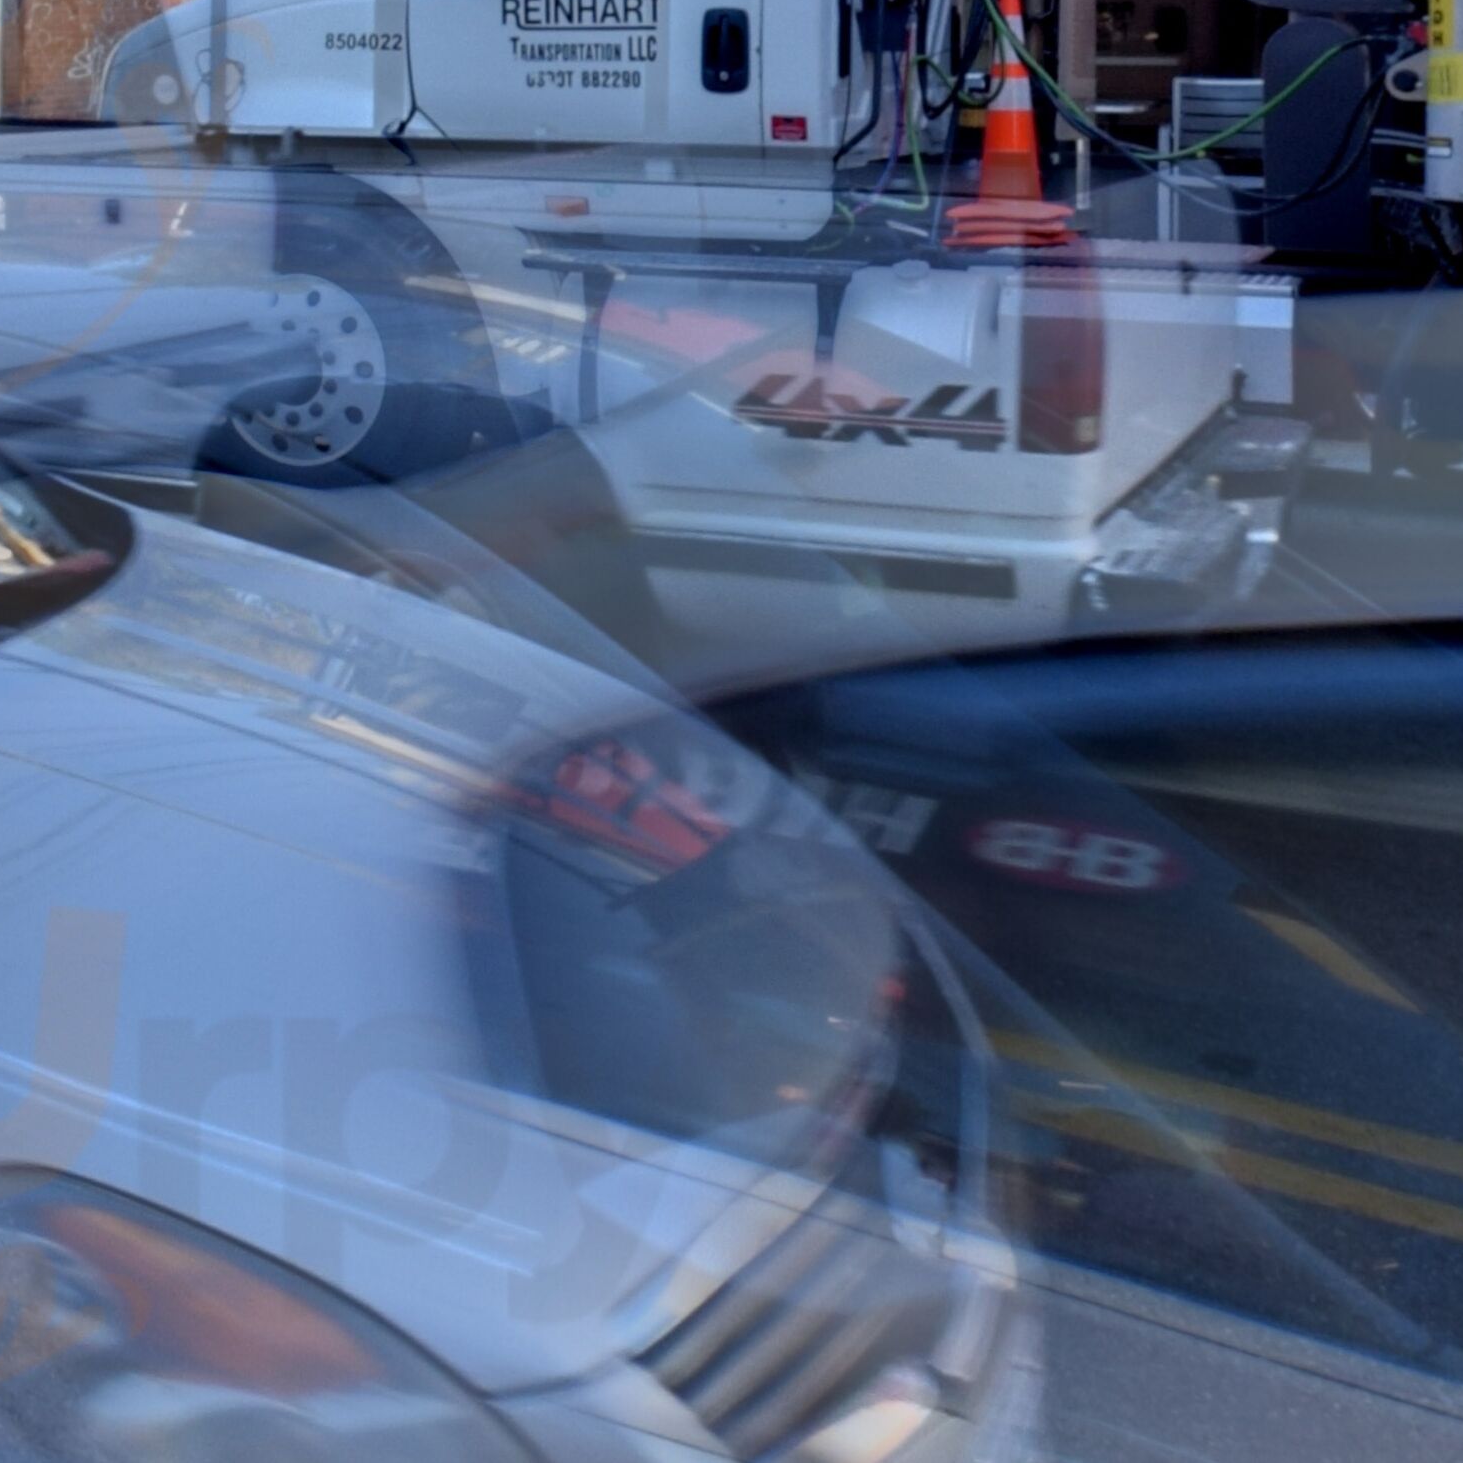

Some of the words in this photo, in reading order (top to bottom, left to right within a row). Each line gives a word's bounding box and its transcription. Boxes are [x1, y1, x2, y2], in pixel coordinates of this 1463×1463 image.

[324, 33, 403, 52] 8504022
[627, 36, 658, 63] LLC
[581, 69, 642, 89] 882290
[734, 372, 1007, 454] 4x4
